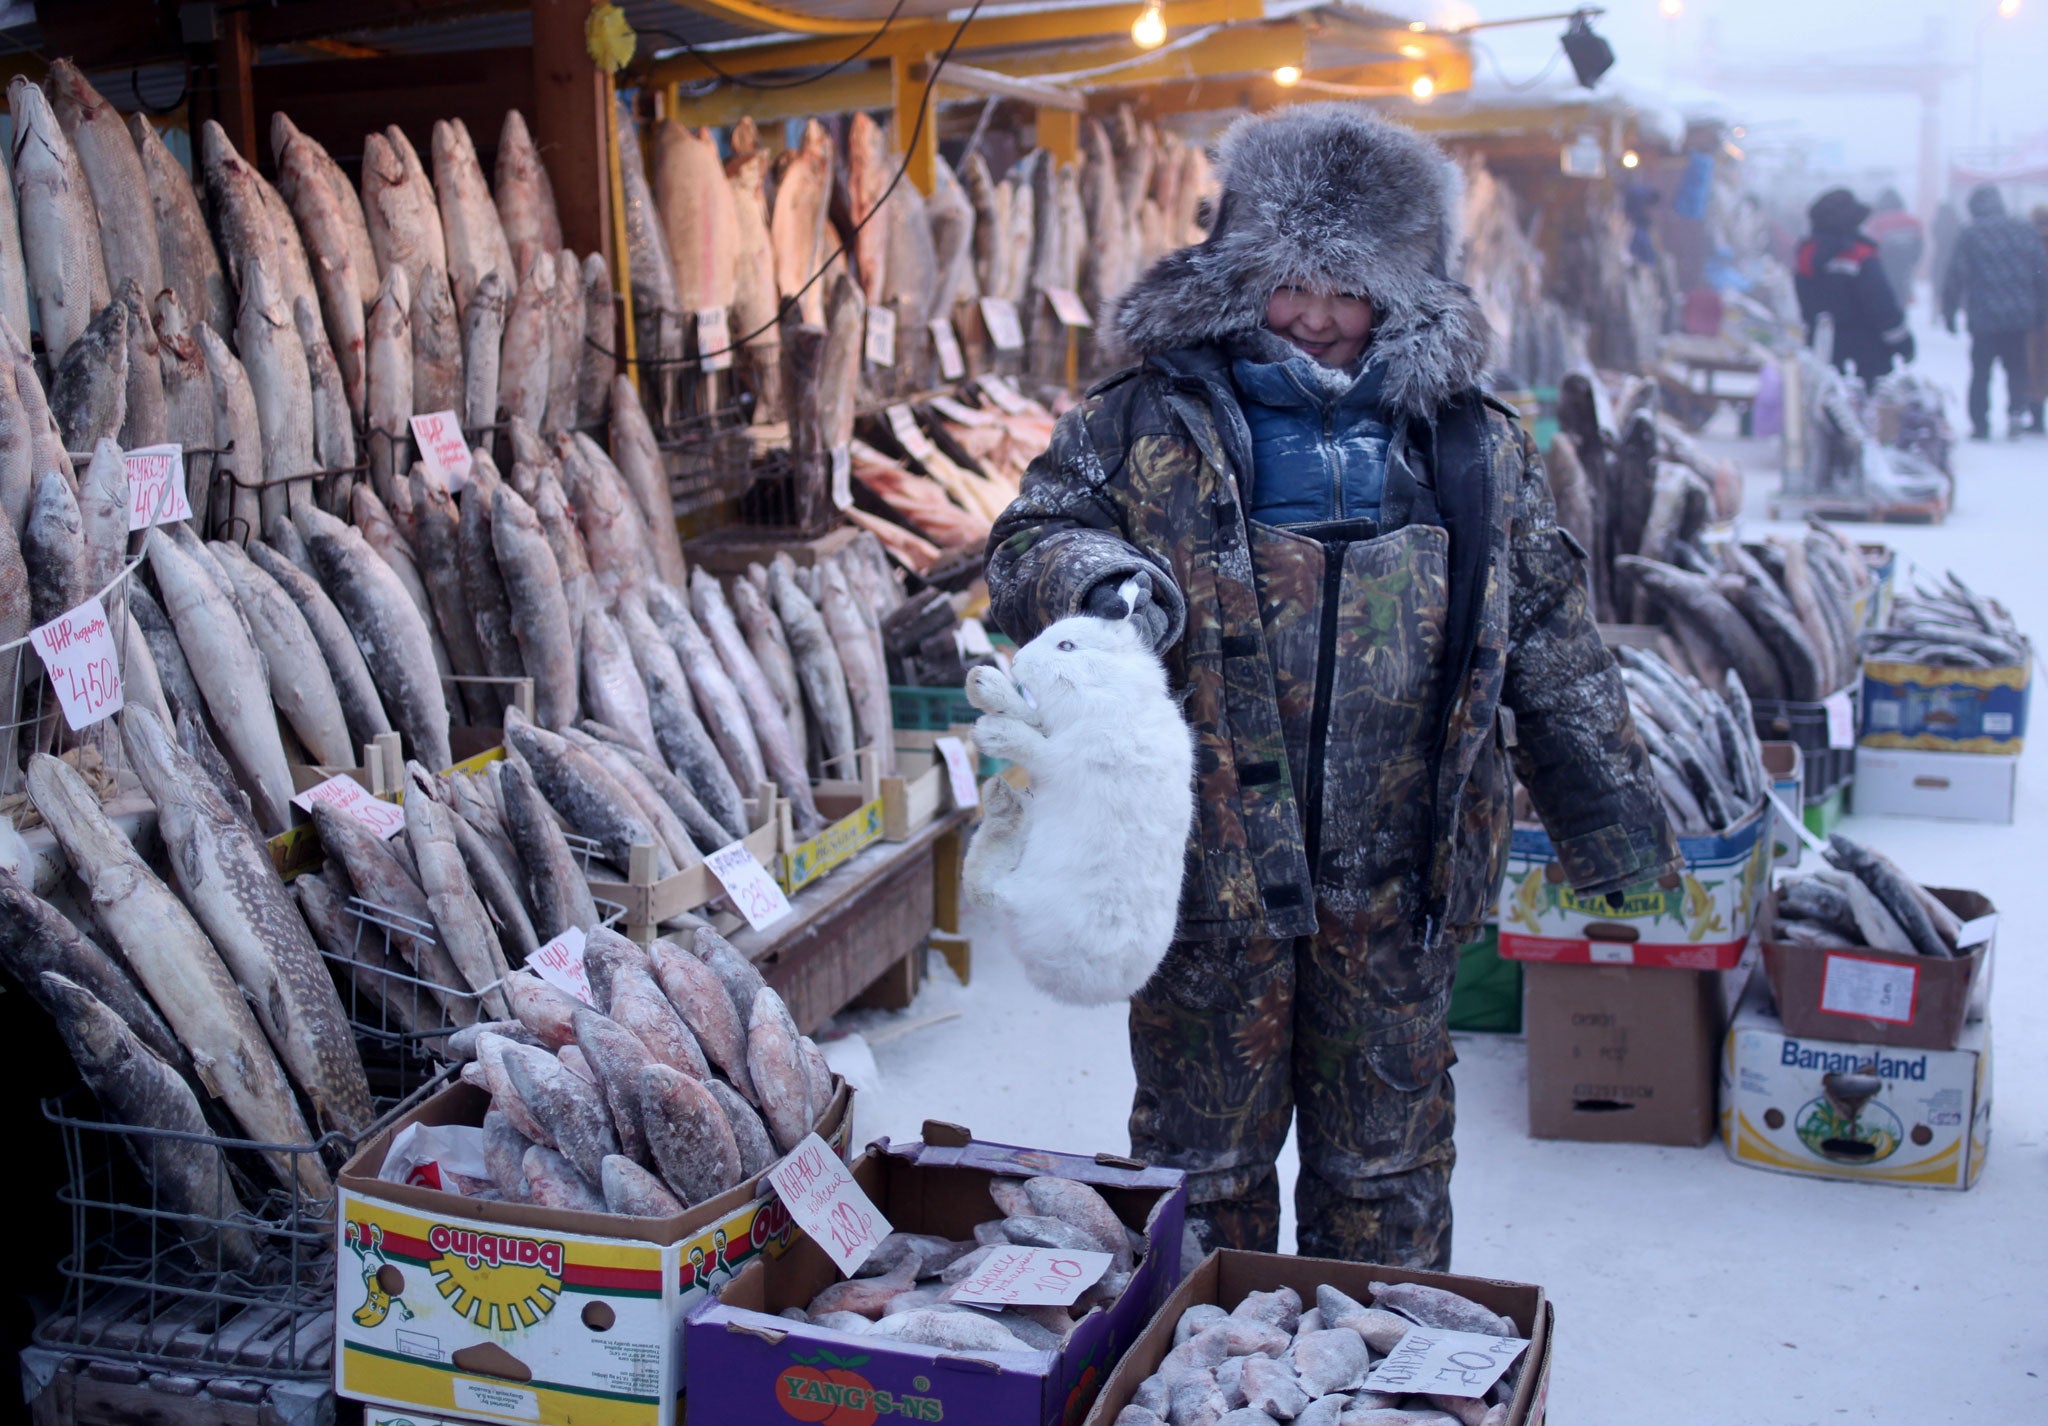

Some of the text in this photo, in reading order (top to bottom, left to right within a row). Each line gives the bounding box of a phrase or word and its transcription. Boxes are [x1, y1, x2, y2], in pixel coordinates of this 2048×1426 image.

[42, 618, 72, 655] ЧИР
[537, 941, 570, 972] ЧИР
[777, 1144, 828, 1204] КАРАСИ
